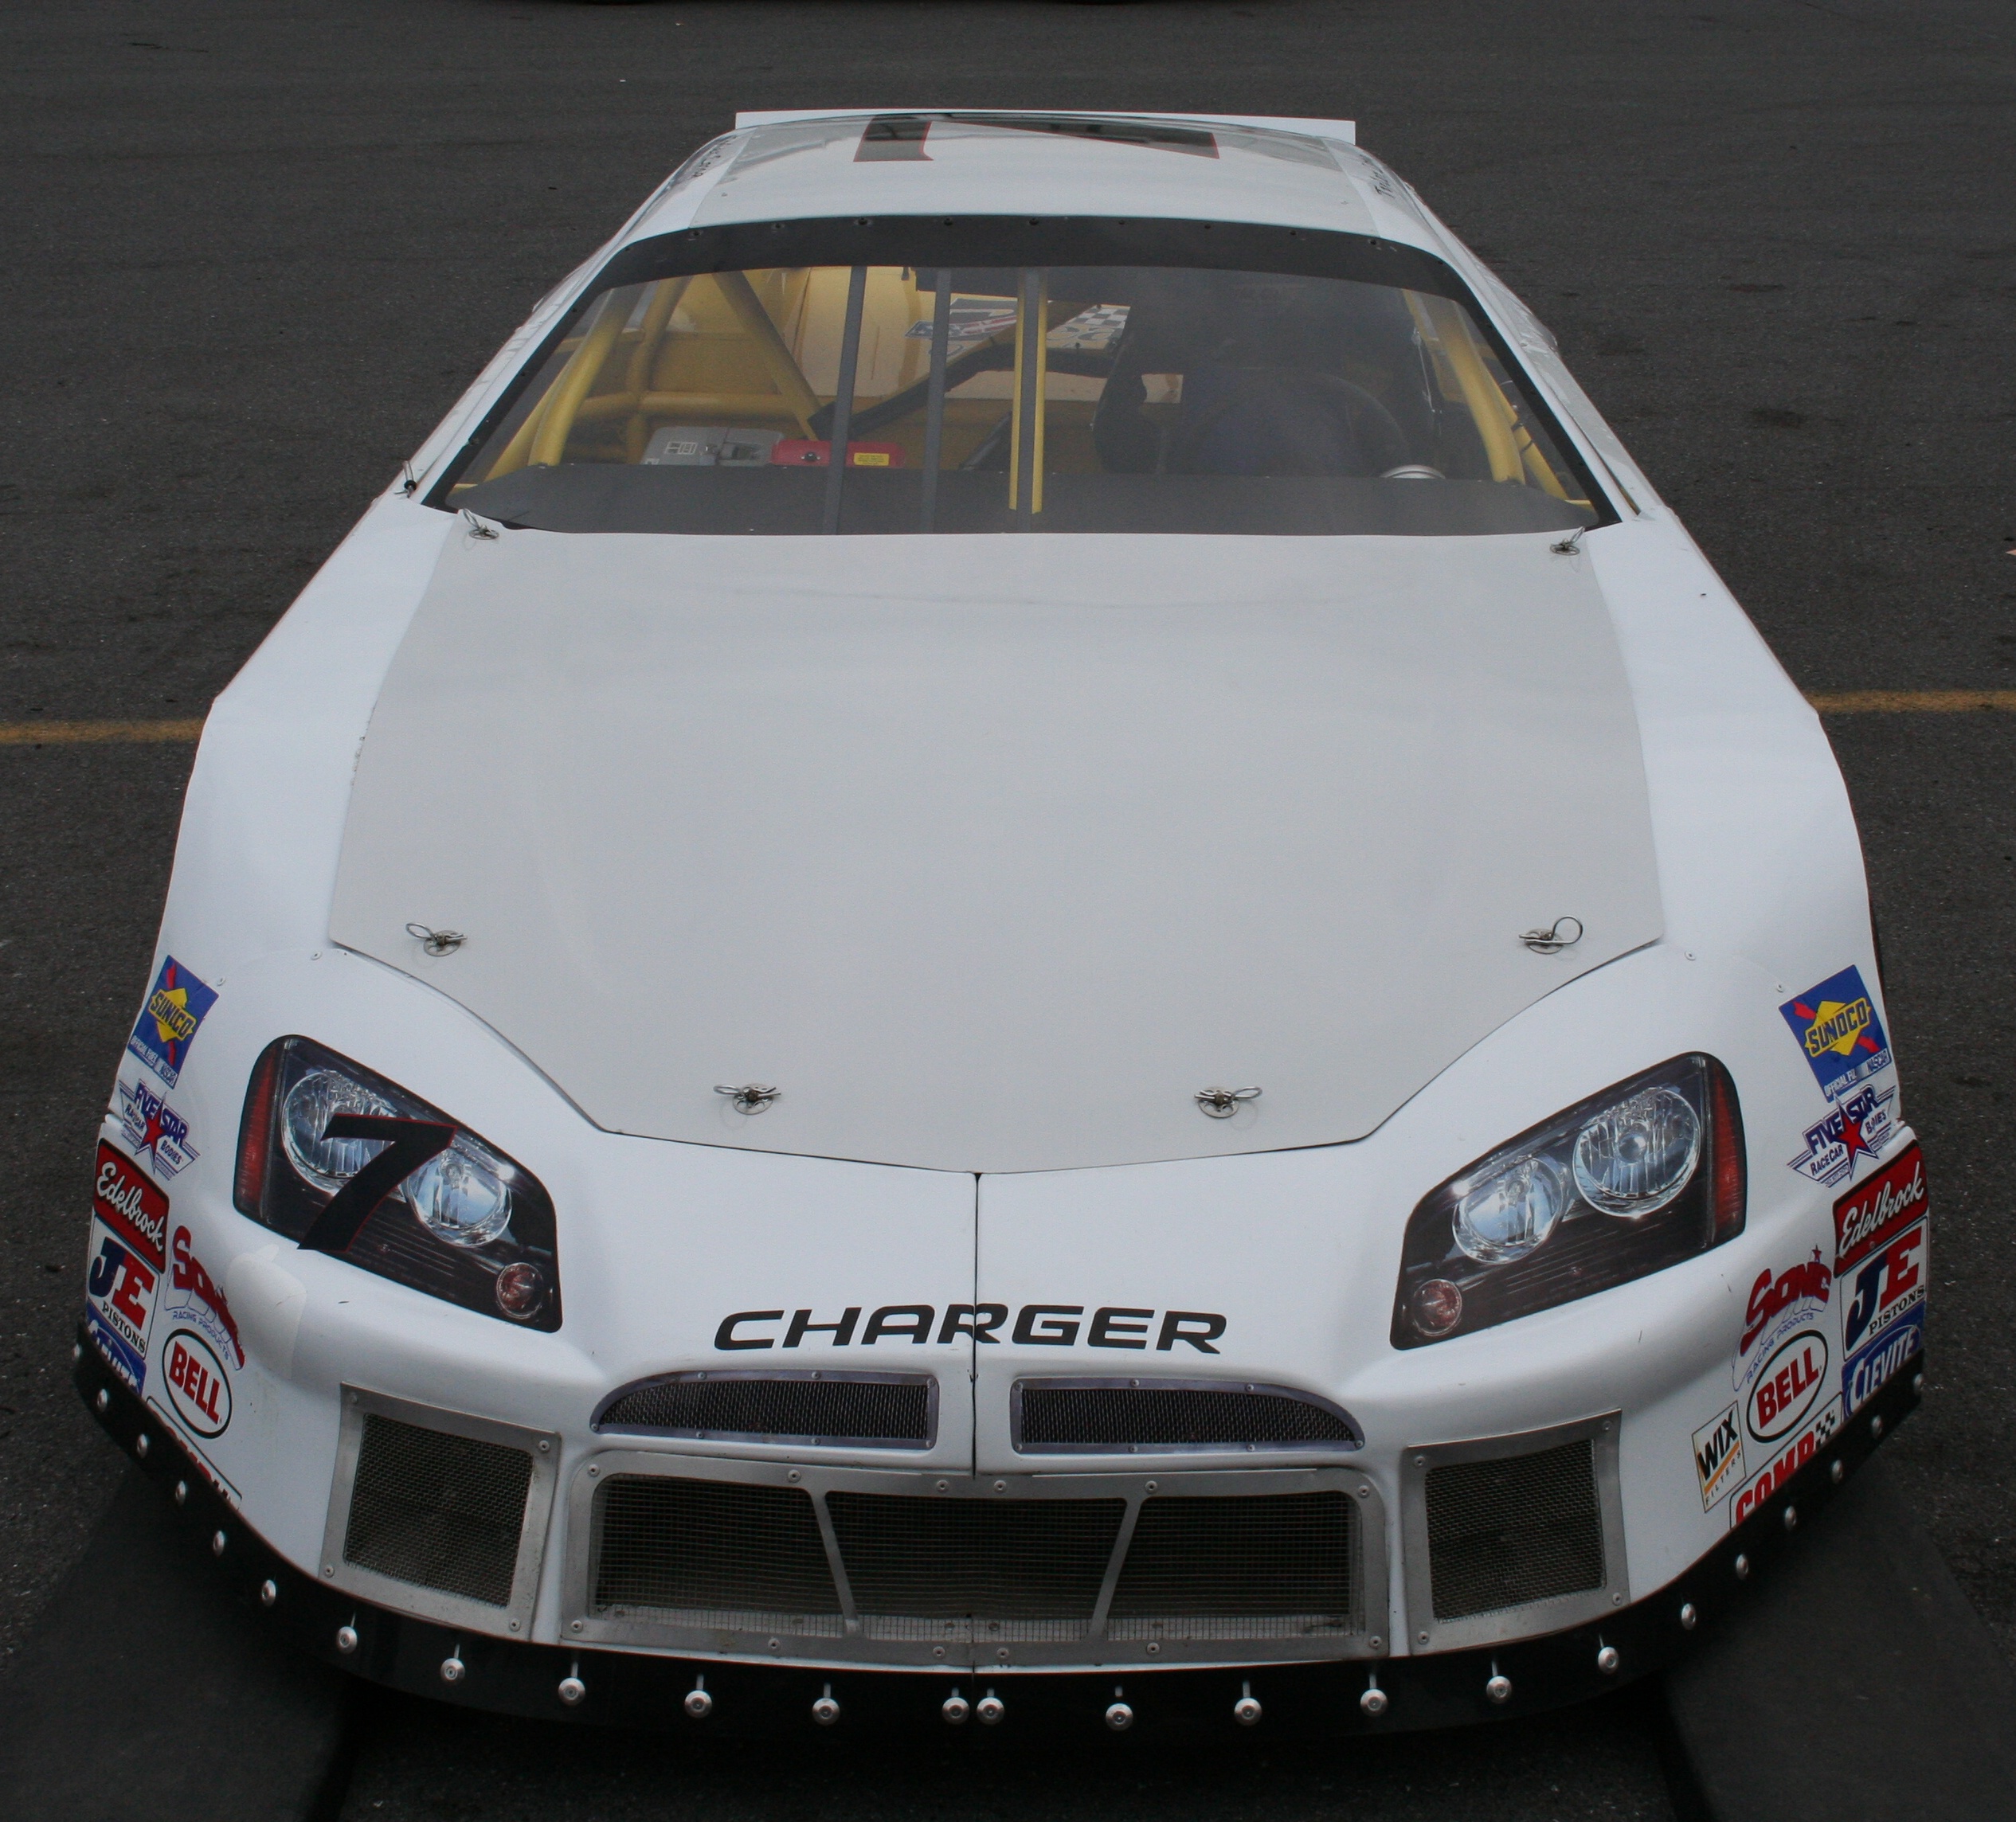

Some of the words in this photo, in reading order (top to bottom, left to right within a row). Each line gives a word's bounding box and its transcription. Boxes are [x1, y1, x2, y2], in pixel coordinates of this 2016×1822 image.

[1807, 1000, 1869, 1054] SUNOCO
[160, 1108, 188, 1147] STAR
[161, 1140, 182, 1165] BODIES
[1805, 1112, 1844, 1155] FIVE
[1846, 1086, 1881, 1124] STAR
[297, 1113, 457, 1253] 7
[1810, 1152, 1831, 1176] RACE
[1829, 1144, 1844, 1163] CAR
[96, 1162, 165, 1253] Edelbrock
[1839, 1161, 1924, 1258] Edelbrock
[89, 1236, 155, 1331] JE
[1846, 1226, 1923, 1351] JE
[1869, 1284, 1925, 1336] PISTONS
[103, 1300, 147, 1354] PISTONS
[714, 1304, 1227, 1355] CHARGER
[1747, 1338, 1775, 1384] RACING
[1777, 1312, 1814, 1339] PRODUCTS
[169, 1341, 220, 1425] BELL
[1756, 1347, 1819, 1429] BELL
[1850, 1327, 1917, 1413] CLEVITE
[1697, 1409, 1738, 1480] WIX
[1705, 1450, 1741, 1506] FILTERS
